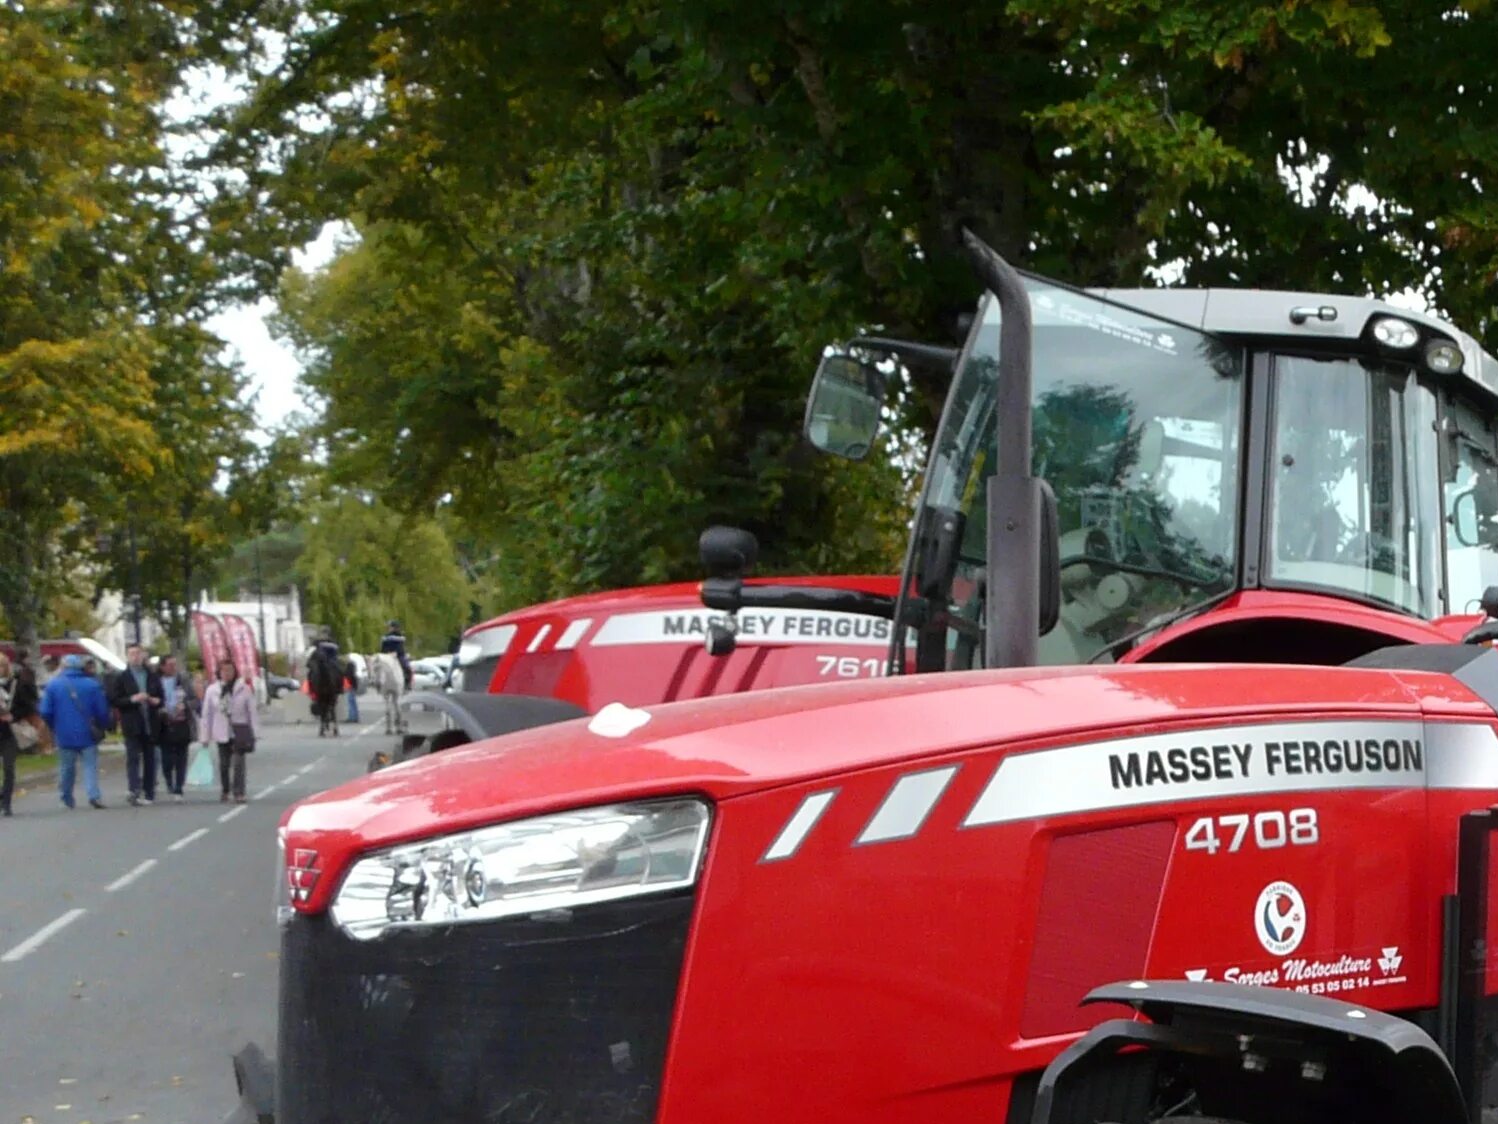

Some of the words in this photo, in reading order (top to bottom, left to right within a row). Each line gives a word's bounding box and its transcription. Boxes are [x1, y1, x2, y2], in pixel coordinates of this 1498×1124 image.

[663, 615, 775, 636] MAEY
[783, 616, 917, 640] FERGUS
[1109, 744, 1254, 788] MASSEY
[1265, 738, 1424, 777] FERGUSON
[1184, 807, 1321, 855] 4708
[1282, 954, 1372, 981] Motoculture
[1312, 983, 1326, 994] 53
[1327, 981, 1341, 992] 05
[1342, 979, 1356, 990] 02
[1357, 976, 1370, 988] 14
